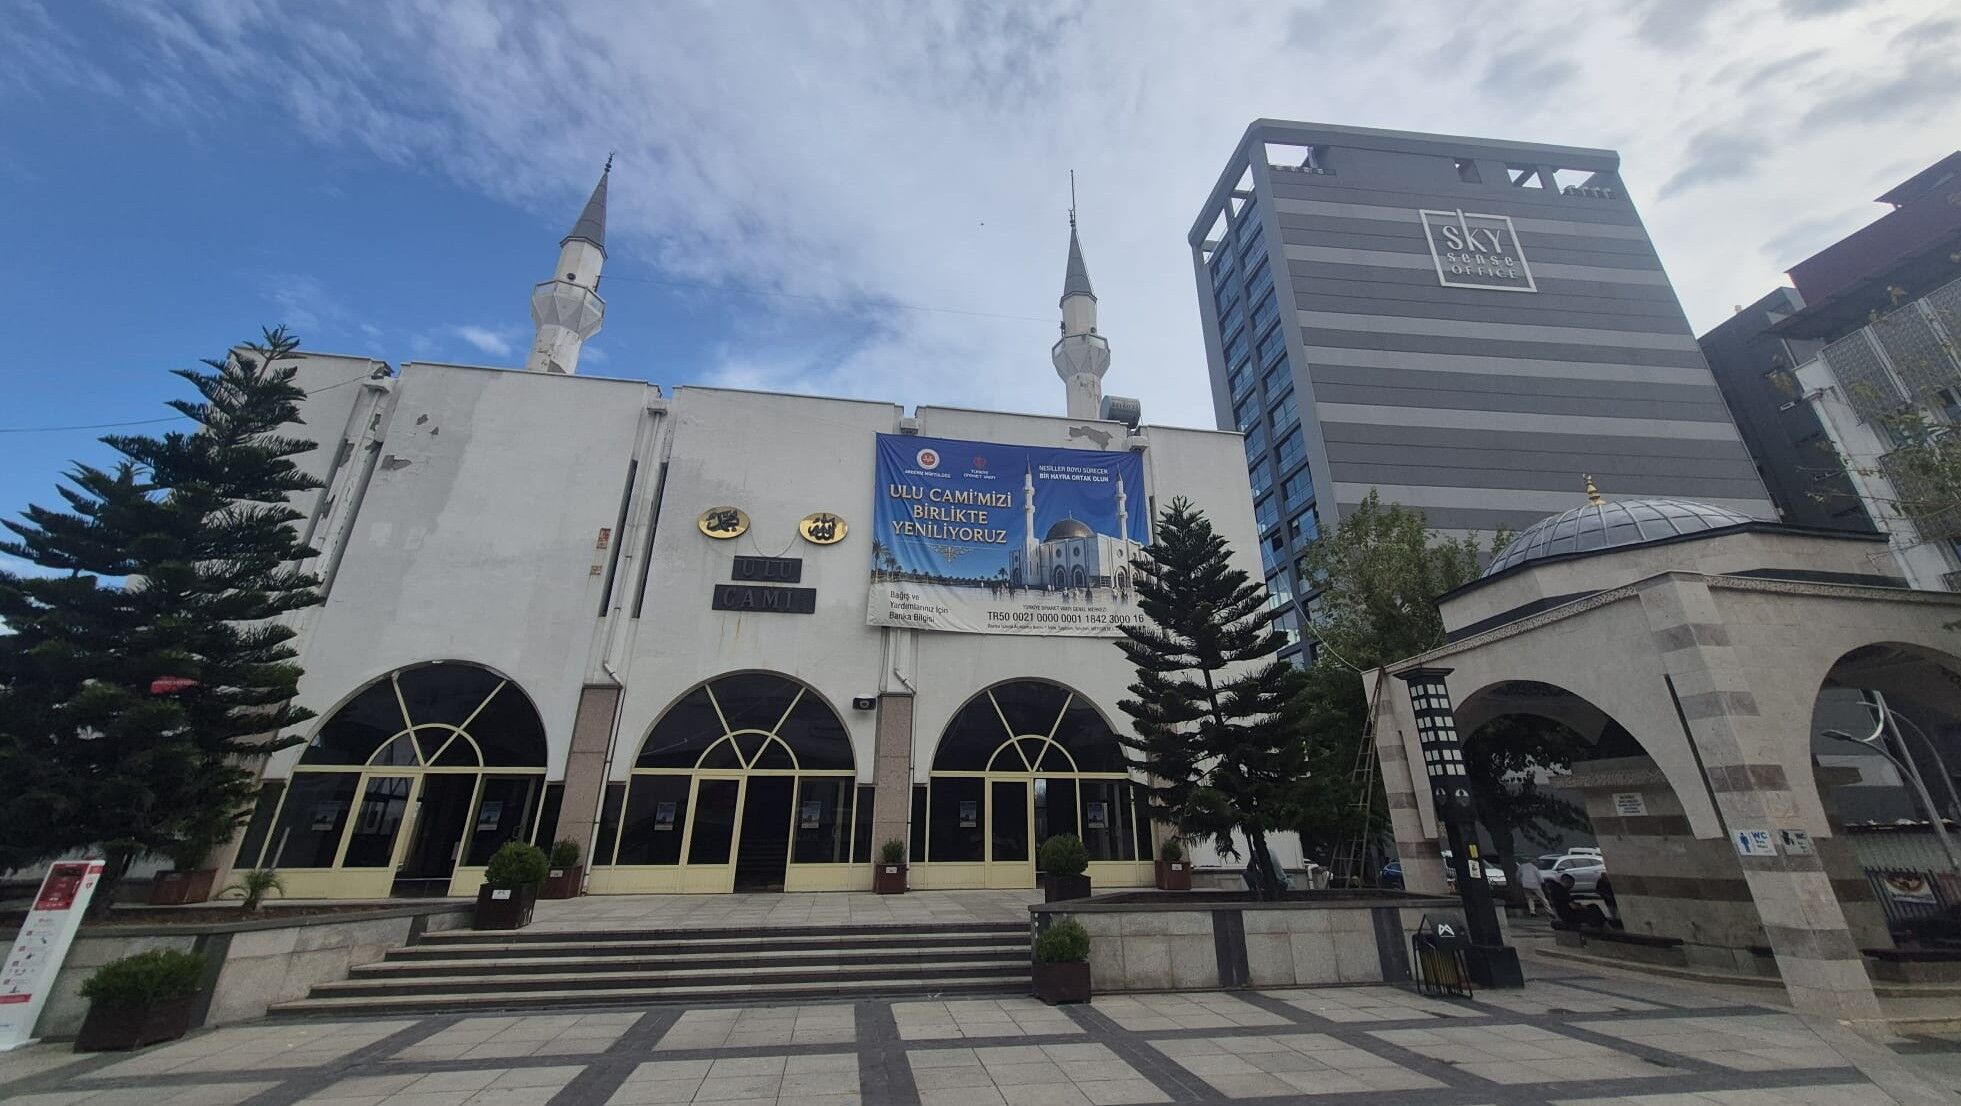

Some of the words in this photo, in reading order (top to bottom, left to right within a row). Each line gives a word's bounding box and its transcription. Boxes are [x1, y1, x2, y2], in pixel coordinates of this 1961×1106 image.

[1442, 208, 1502, 253] SKY
[1447, 252, 1514, 267] sense
[1451, 265, 1518, 279] OFFICE
[890, 484, 924, 500] ULU
[929, 488, 1012, 508] CAMİ'MİZİ
[913, 502, 988, 524] BİRLİKTE
[892, 520, 1007, 543] YENİLİYORUZ
[742, 558, 793, 578] ULU
[889, 611, 912, 621] Banka
[987, 611, 1010, 621] TR50
[1012, 612, 1034, 622] 0021
[1036, 613, 1059, 623] 0000
[1061, 614, 1082, 623] 0001
[1085, 614, 1107, 624] 1842
[1109, 614, 1131, 623] 3000
[1133, 613, 1144, 623] 16
[1751, 831, 1768, 839] WC
